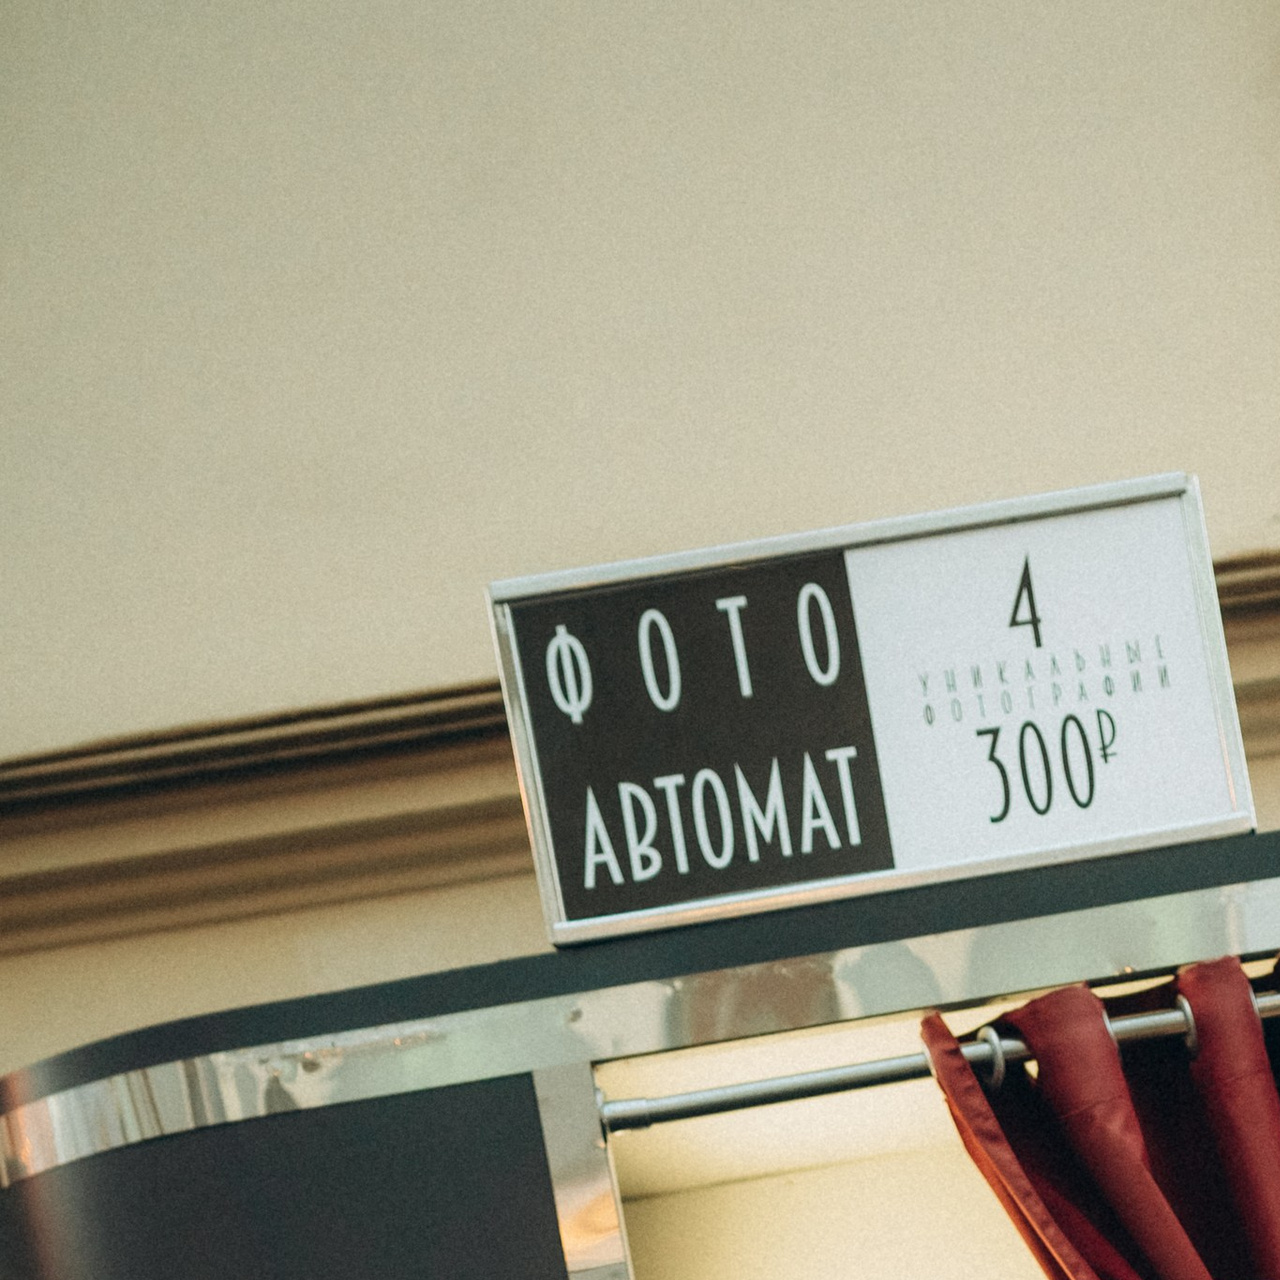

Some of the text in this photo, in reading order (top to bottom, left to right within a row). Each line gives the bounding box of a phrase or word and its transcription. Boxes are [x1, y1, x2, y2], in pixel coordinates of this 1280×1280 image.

[546, 583, 841, 725] ФОТО
[1008, 553, 1042, 648] 4
[584, 746, 862, 890] АВТОМАТ
